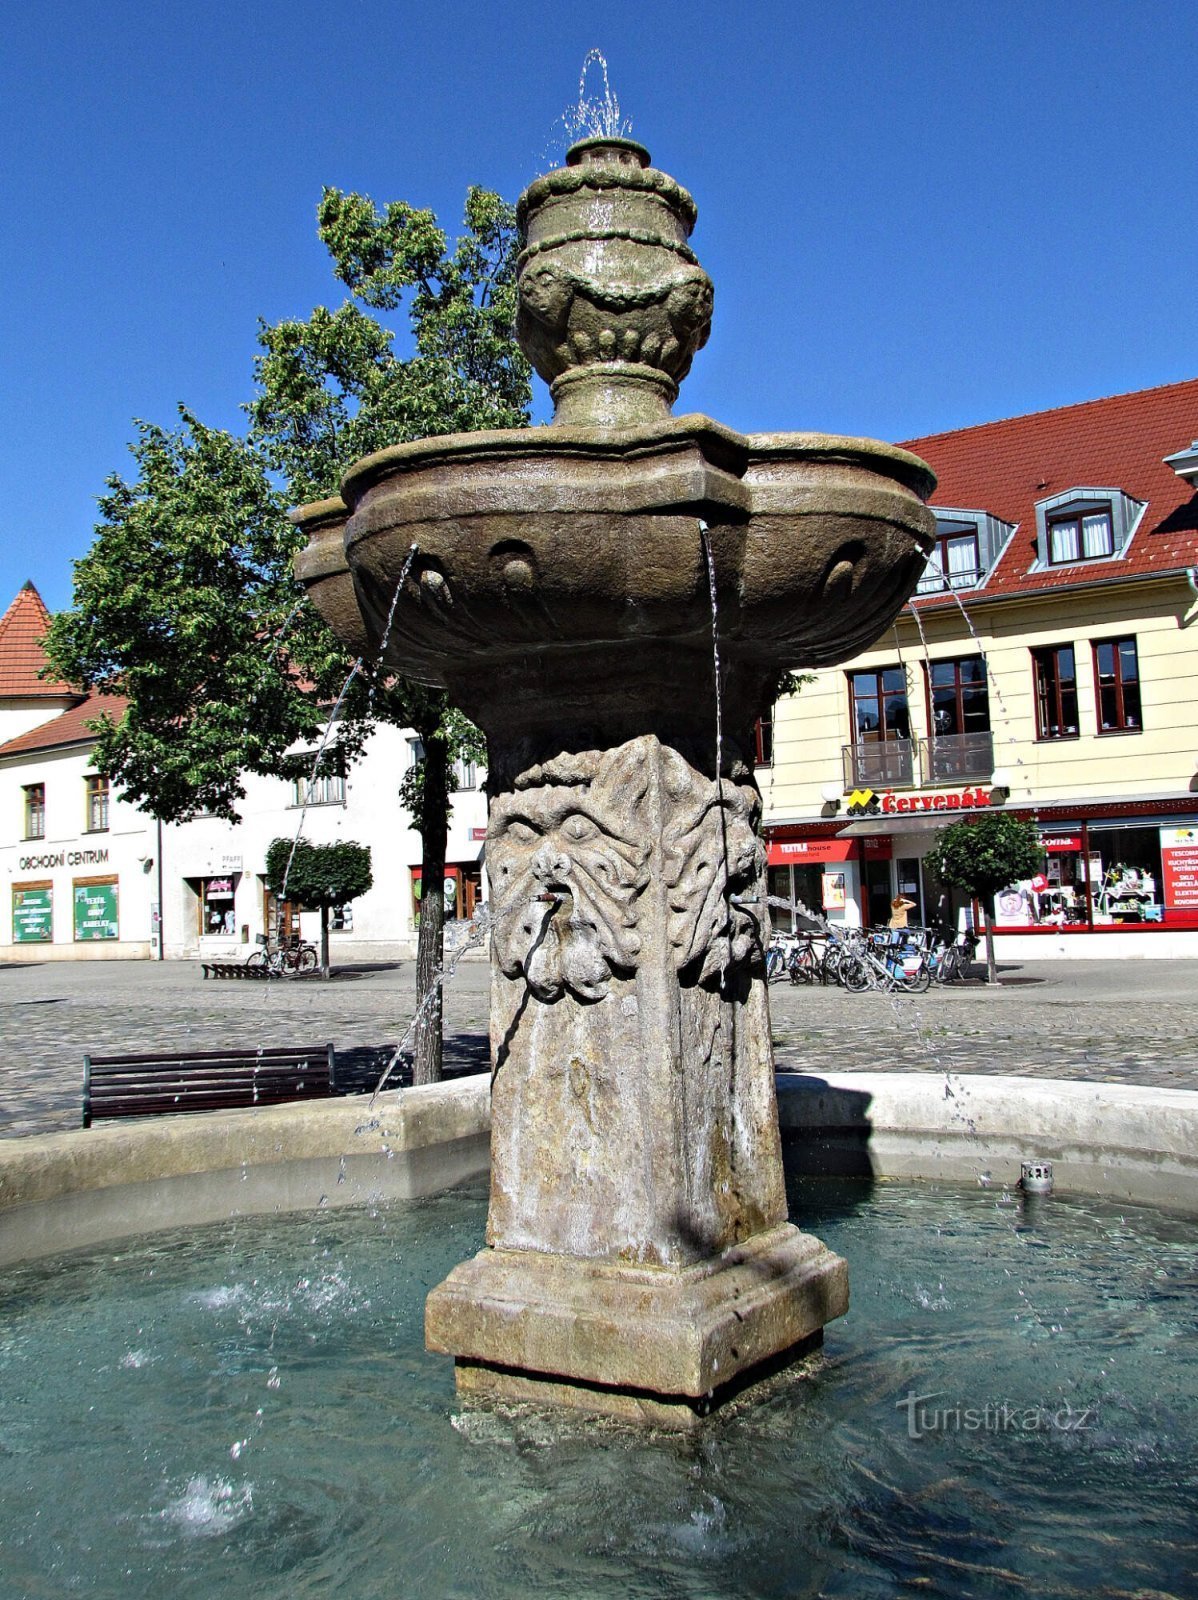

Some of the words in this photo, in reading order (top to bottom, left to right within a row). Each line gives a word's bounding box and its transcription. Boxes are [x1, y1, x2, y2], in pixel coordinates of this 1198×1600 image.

[882, 786, 991, 813] Červenák
[19, 850, 65, 870] OBCHODNÍ
[67, 849, 109, 866] CENTRUM
